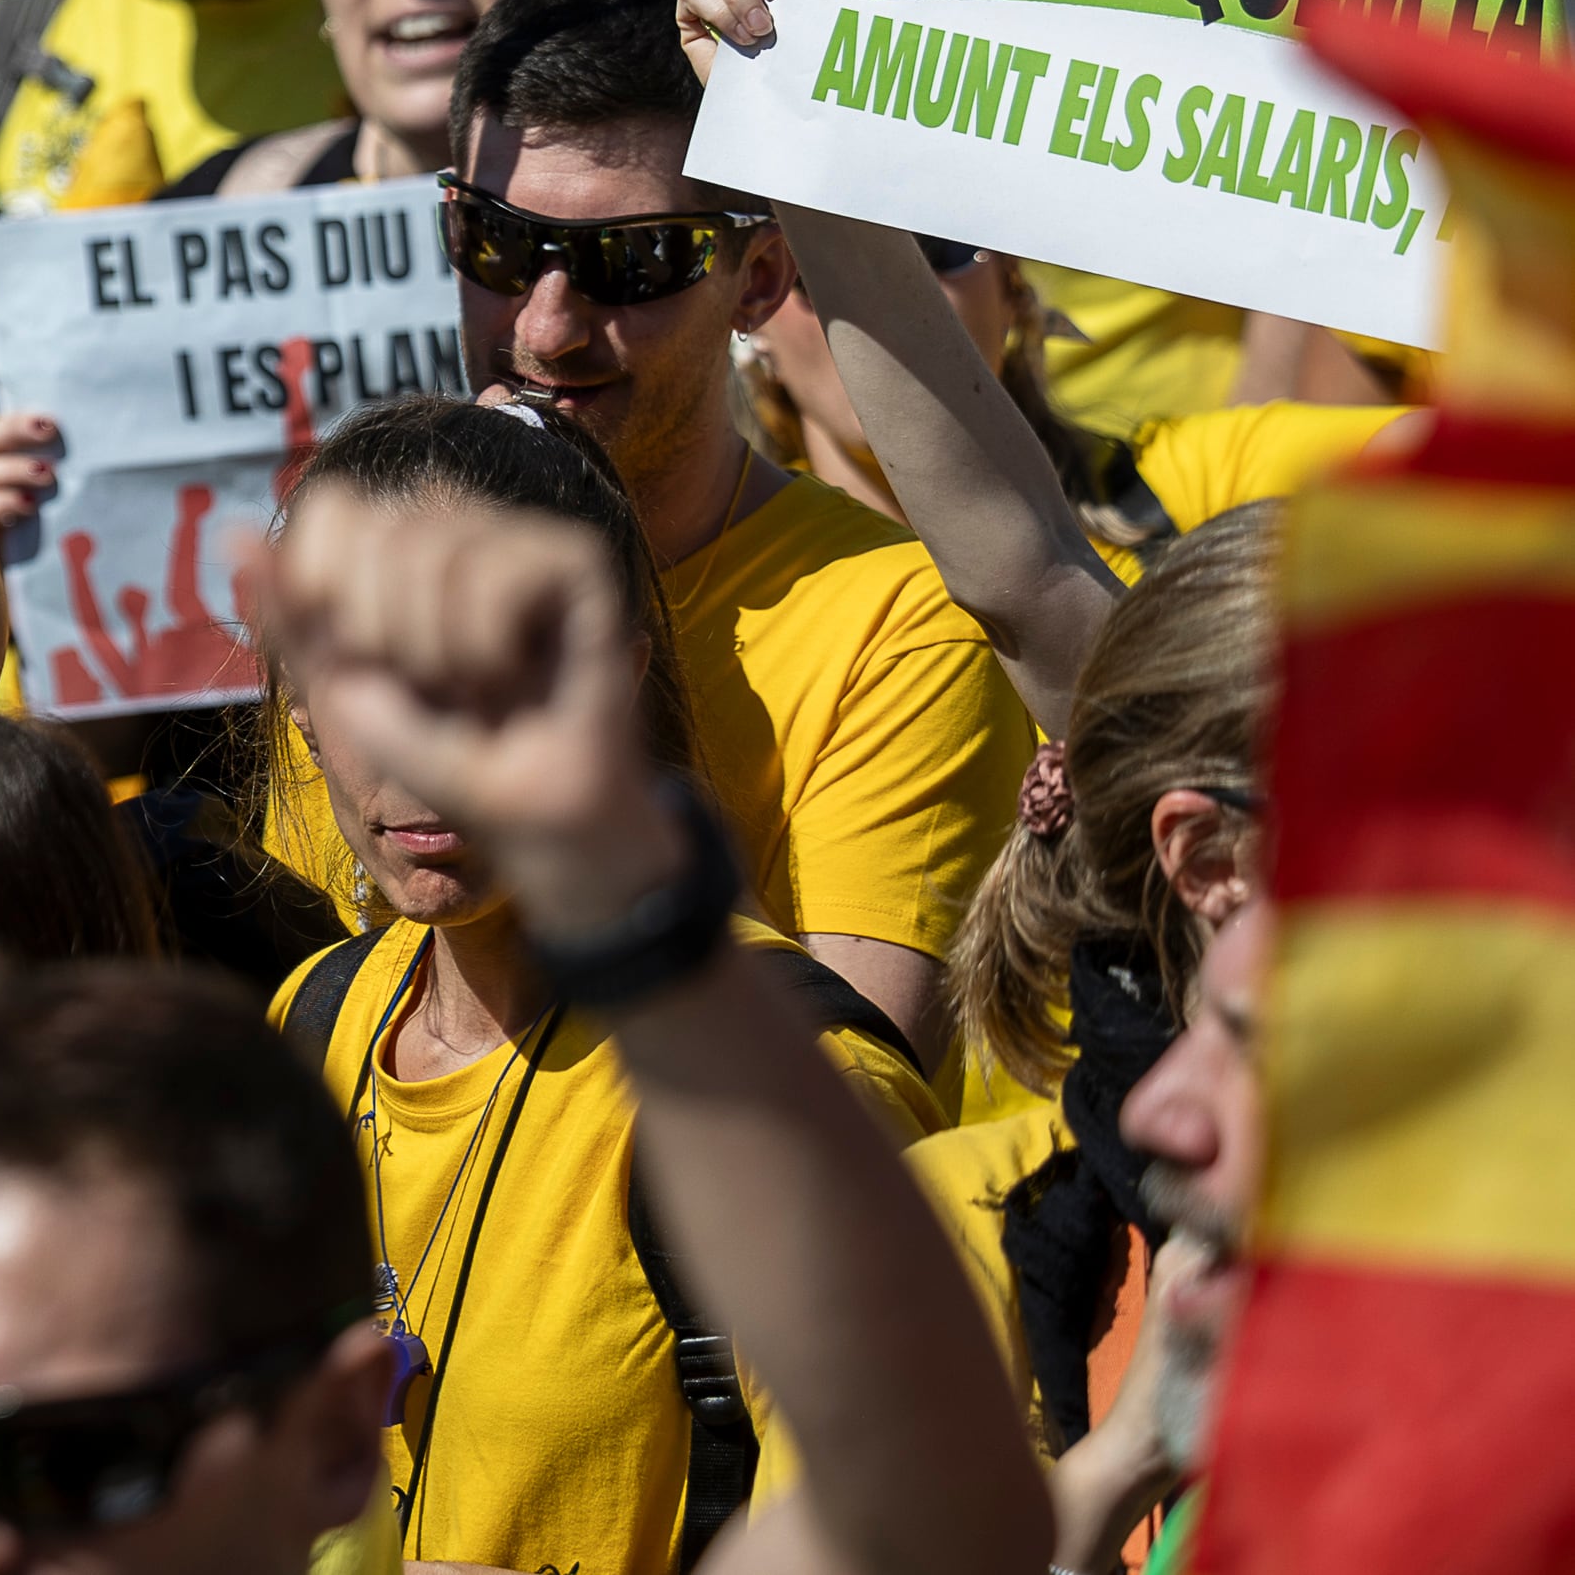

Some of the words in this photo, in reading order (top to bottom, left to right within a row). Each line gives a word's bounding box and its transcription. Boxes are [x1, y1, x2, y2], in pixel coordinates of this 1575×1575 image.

[811, 6, 1053, 148] AMUNT
[1049, 58, 1163, 174] ELS
[1162, 85, 1426, 257] SALARIS,
[85, 236, 157, 312] EL
[175, 224, 293, 304] PAS
[315, 208, 413, 291] DIU
[178, 352, 199, 420] I
